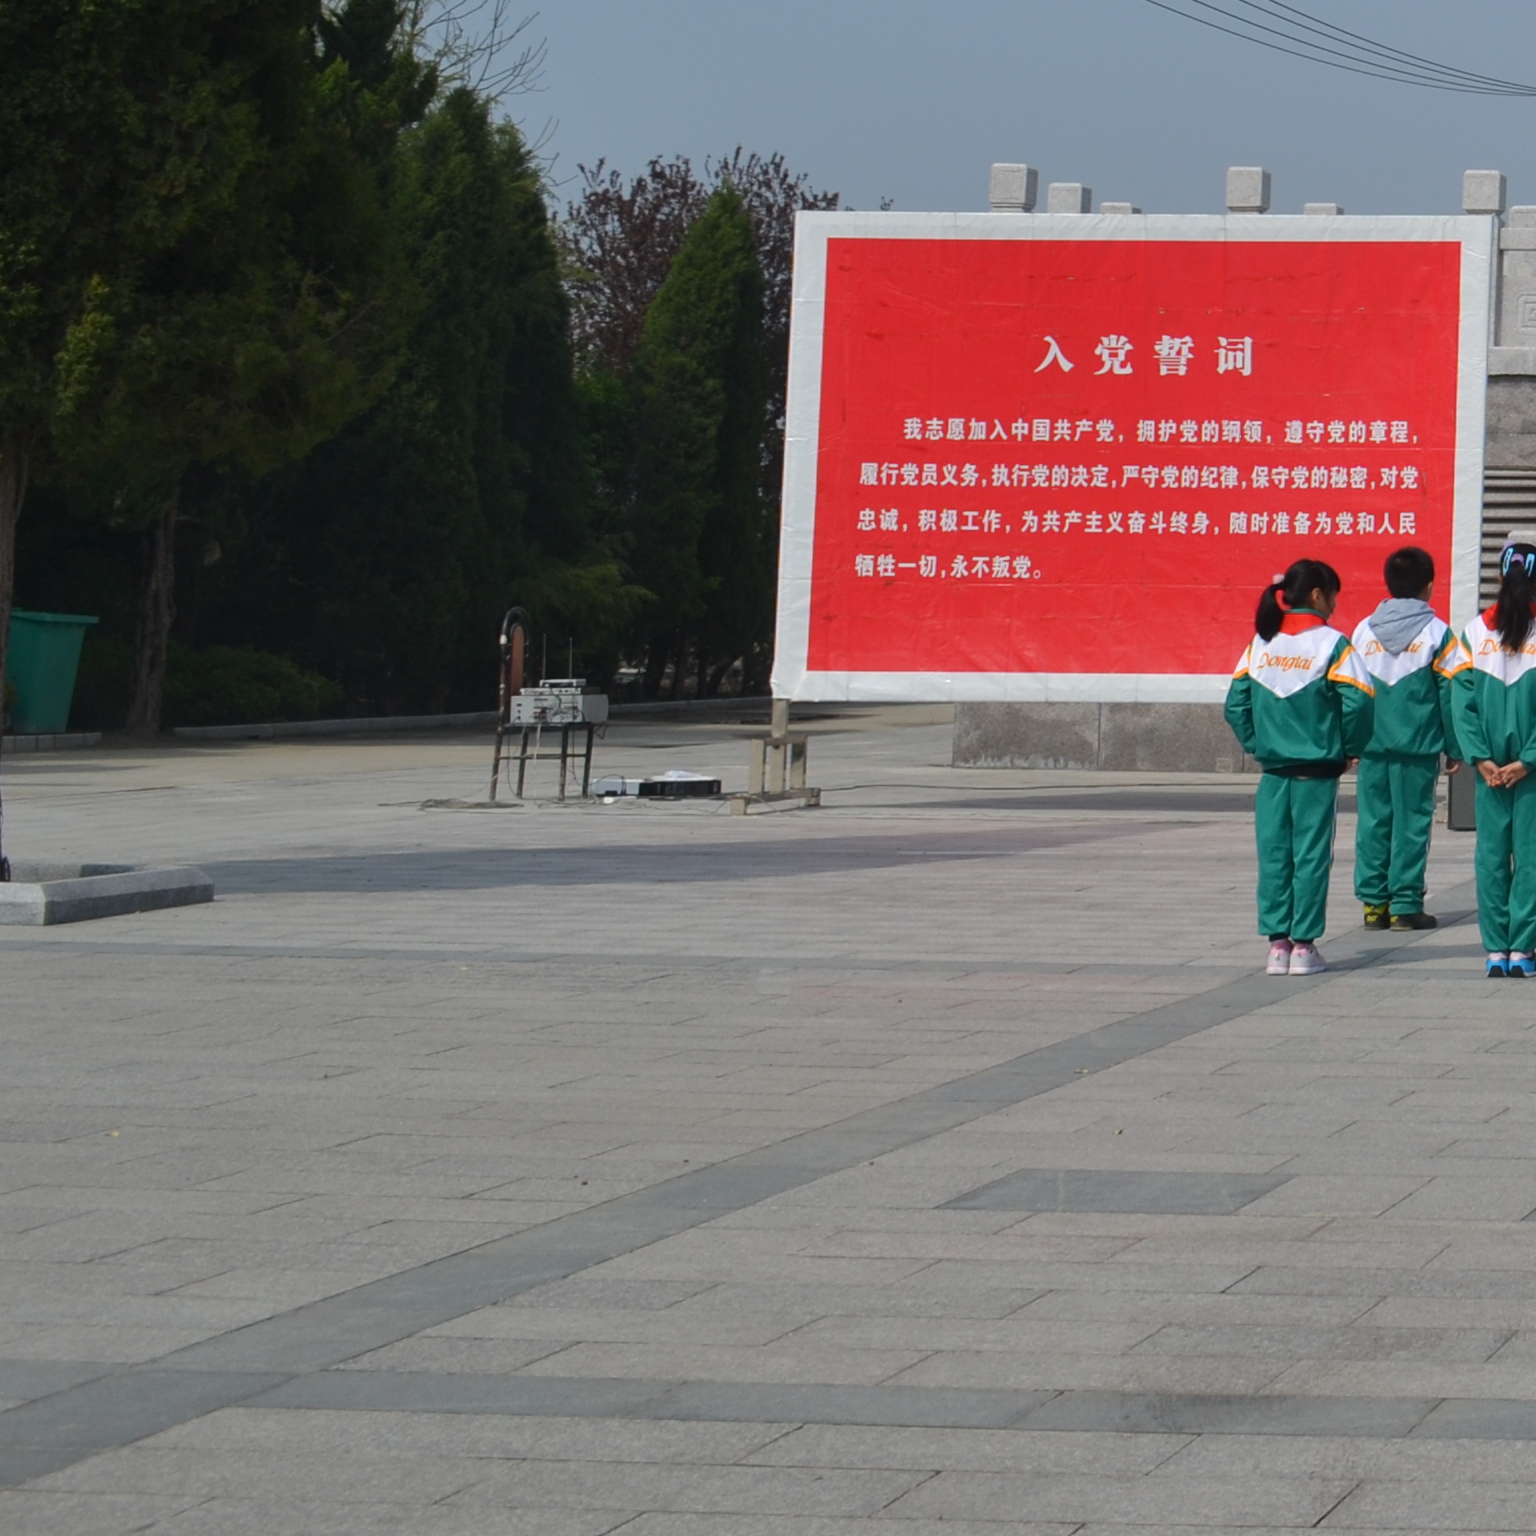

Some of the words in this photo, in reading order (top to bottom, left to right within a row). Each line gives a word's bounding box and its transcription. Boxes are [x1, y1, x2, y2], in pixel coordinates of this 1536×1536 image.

[1034, 334, 1253, 377] 入党誓词
[903, 417, 1418, 444] 我志愿加入中国共产党，拥护党的纲领，遵守党的章程，
[857, 508, 1416, 535] 忠诚，积极工作，为共产主义奋斗终身，随时准备为党和人民
[855, 553, 1041, 579] 牺牲一切，永不叛党。
